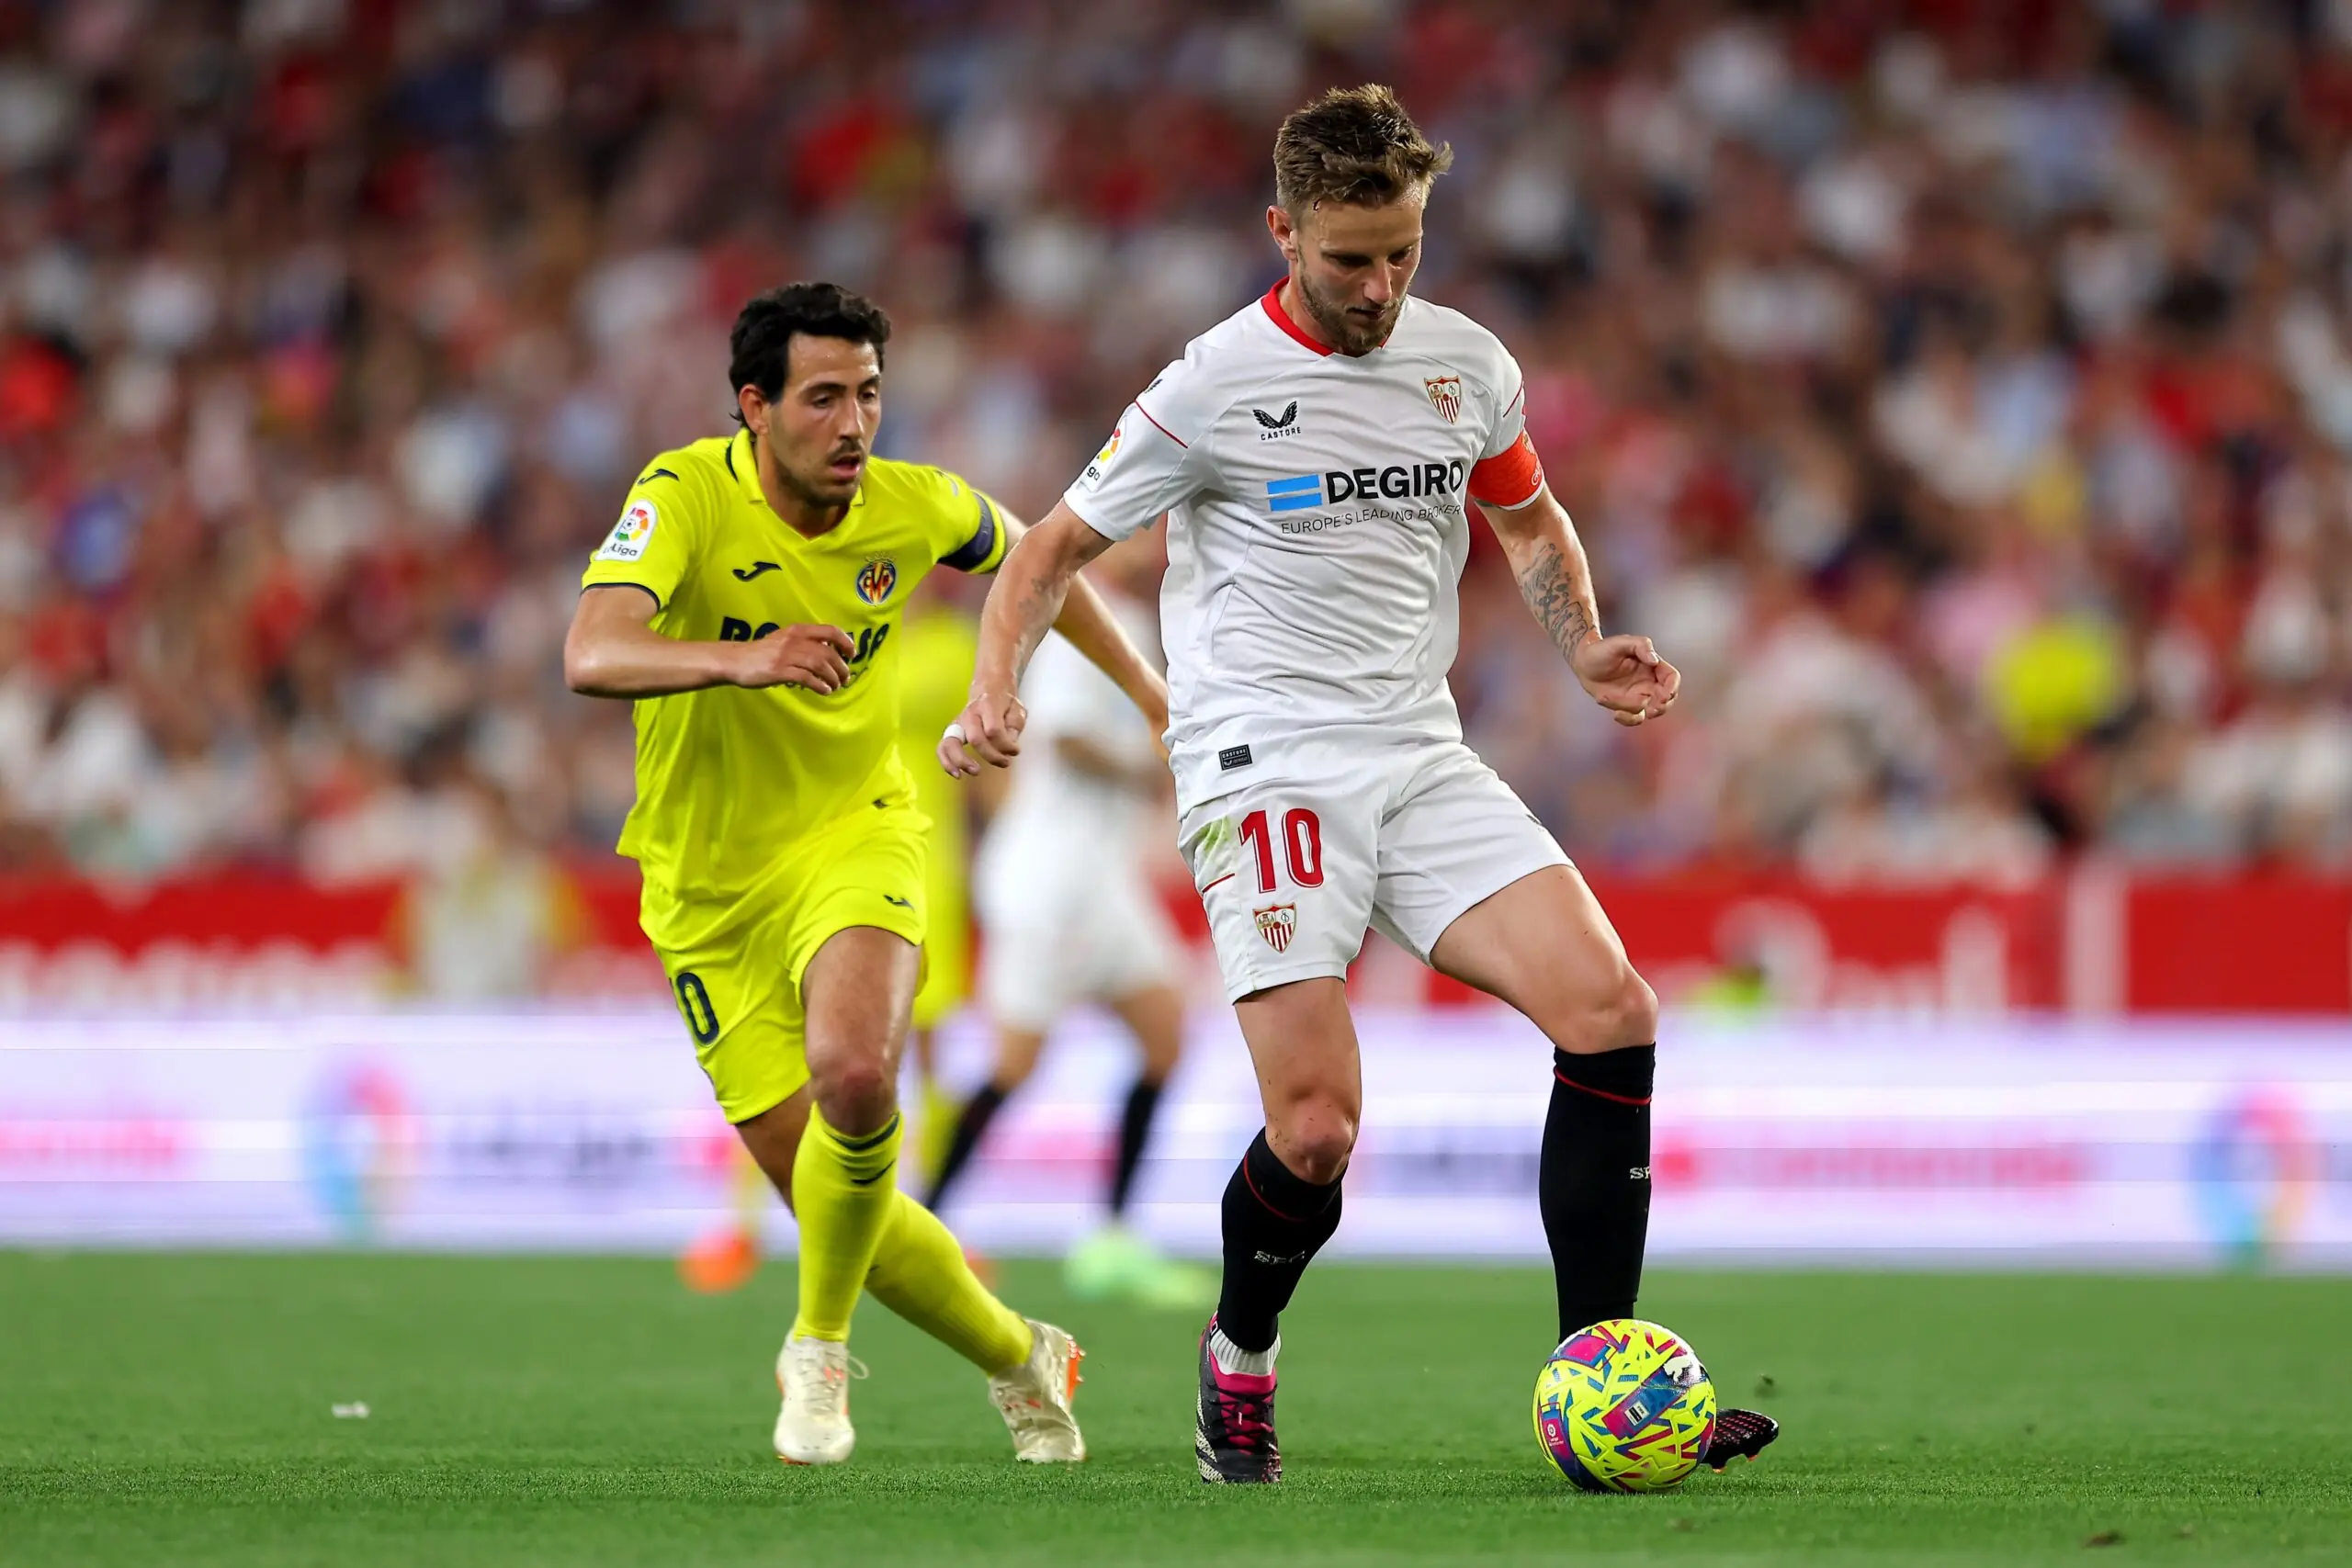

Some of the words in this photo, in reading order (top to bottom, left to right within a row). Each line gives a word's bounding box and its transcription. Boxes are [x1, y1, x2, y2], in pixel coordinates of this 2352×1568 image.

[1261, 426, 1301, 441] CASTORE
[1325, 461, 1464, 504] DEGIRO
[1282, 513, 1352, 534] EUROPE'S
[1356, 508, 1413, 523] LEADING
[1418, 504, 1461, 520] BROKER
[1238, 807, 1324, 894] 10
